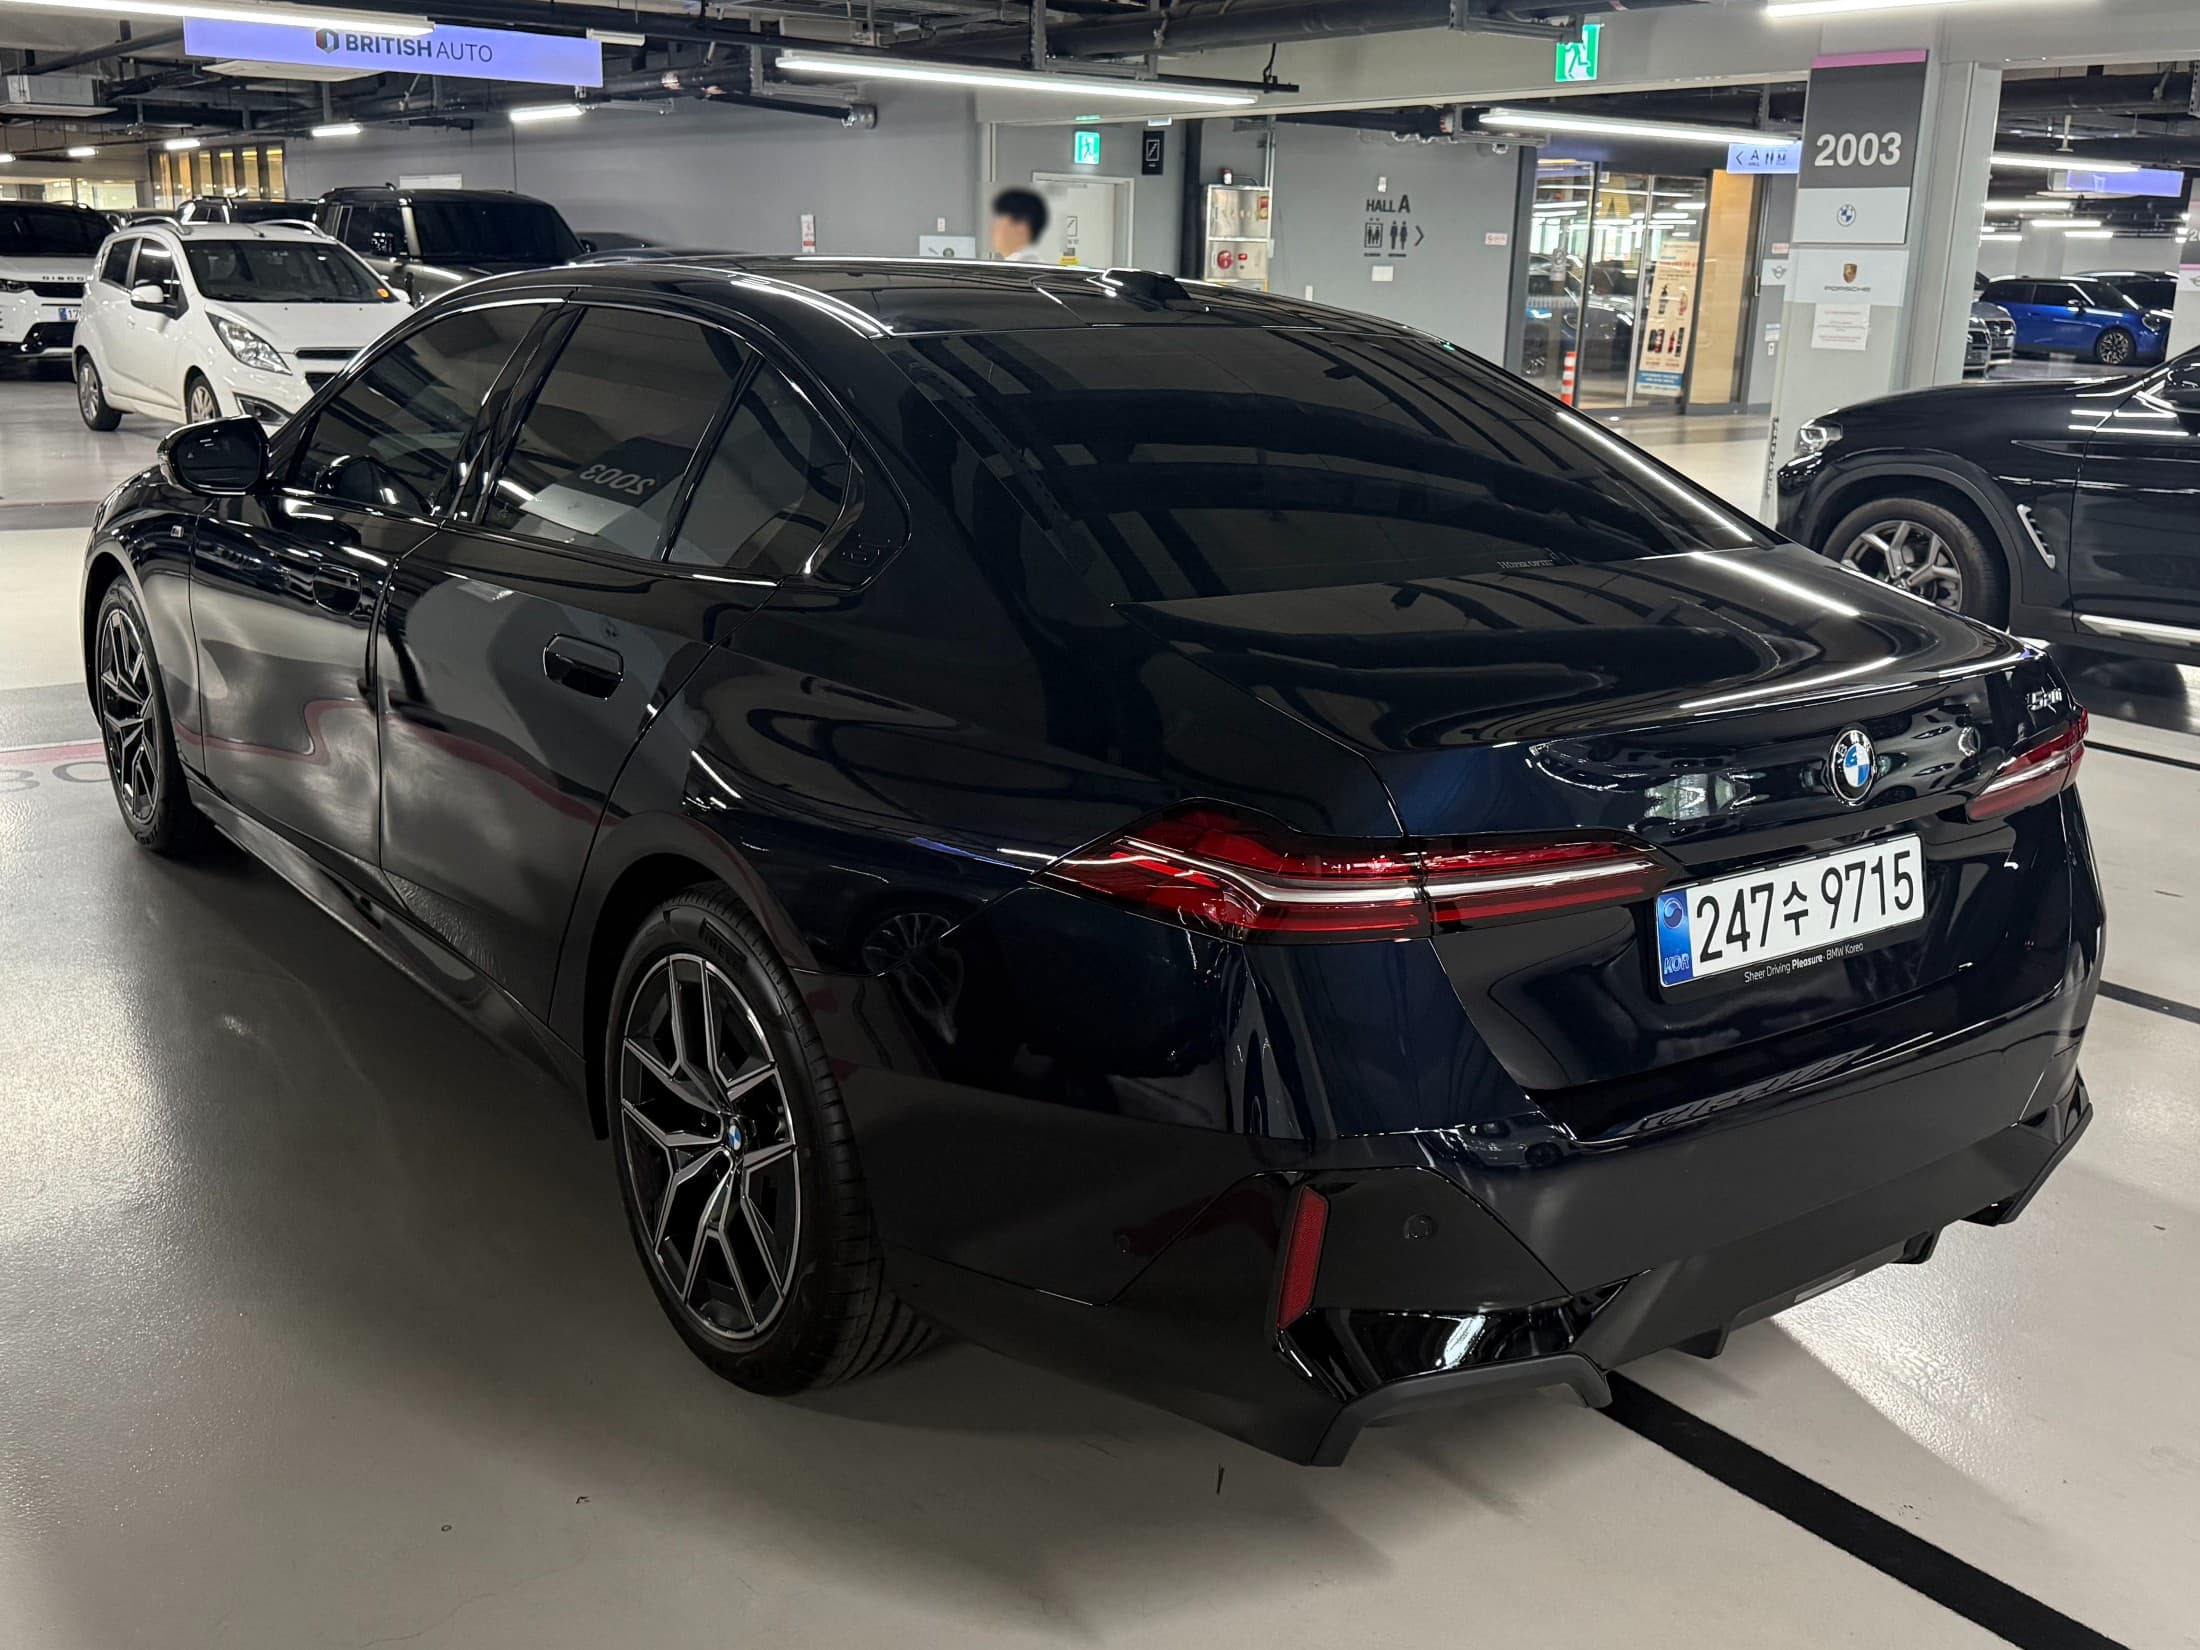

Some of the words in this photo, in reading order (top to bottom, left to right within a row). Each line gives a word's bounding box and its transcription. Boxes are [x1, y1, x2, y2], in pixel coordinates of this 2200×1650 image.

[346, 33, 432, 58] BRITISH
[436, 41, 493, 63] AUTO
[1814, 131, 1902, 167] 2003
[1365, 199, 1396, 213] HALL
[1398, 194, 1411, 213] A
[1696, 881, 1809, 963] 247수
[1820, 850, 1914, 930] 9715
[1663, 953, 1690, 975] KOR
[1744, 970, 1765, 983] Sheer
[1766, 962, 1791, 977] Driving
[1791, 953, 1823, 970] Pleasure
[1826, 947, 1845, 961] BMW
[1845, 942, 1864, 956] Korea
